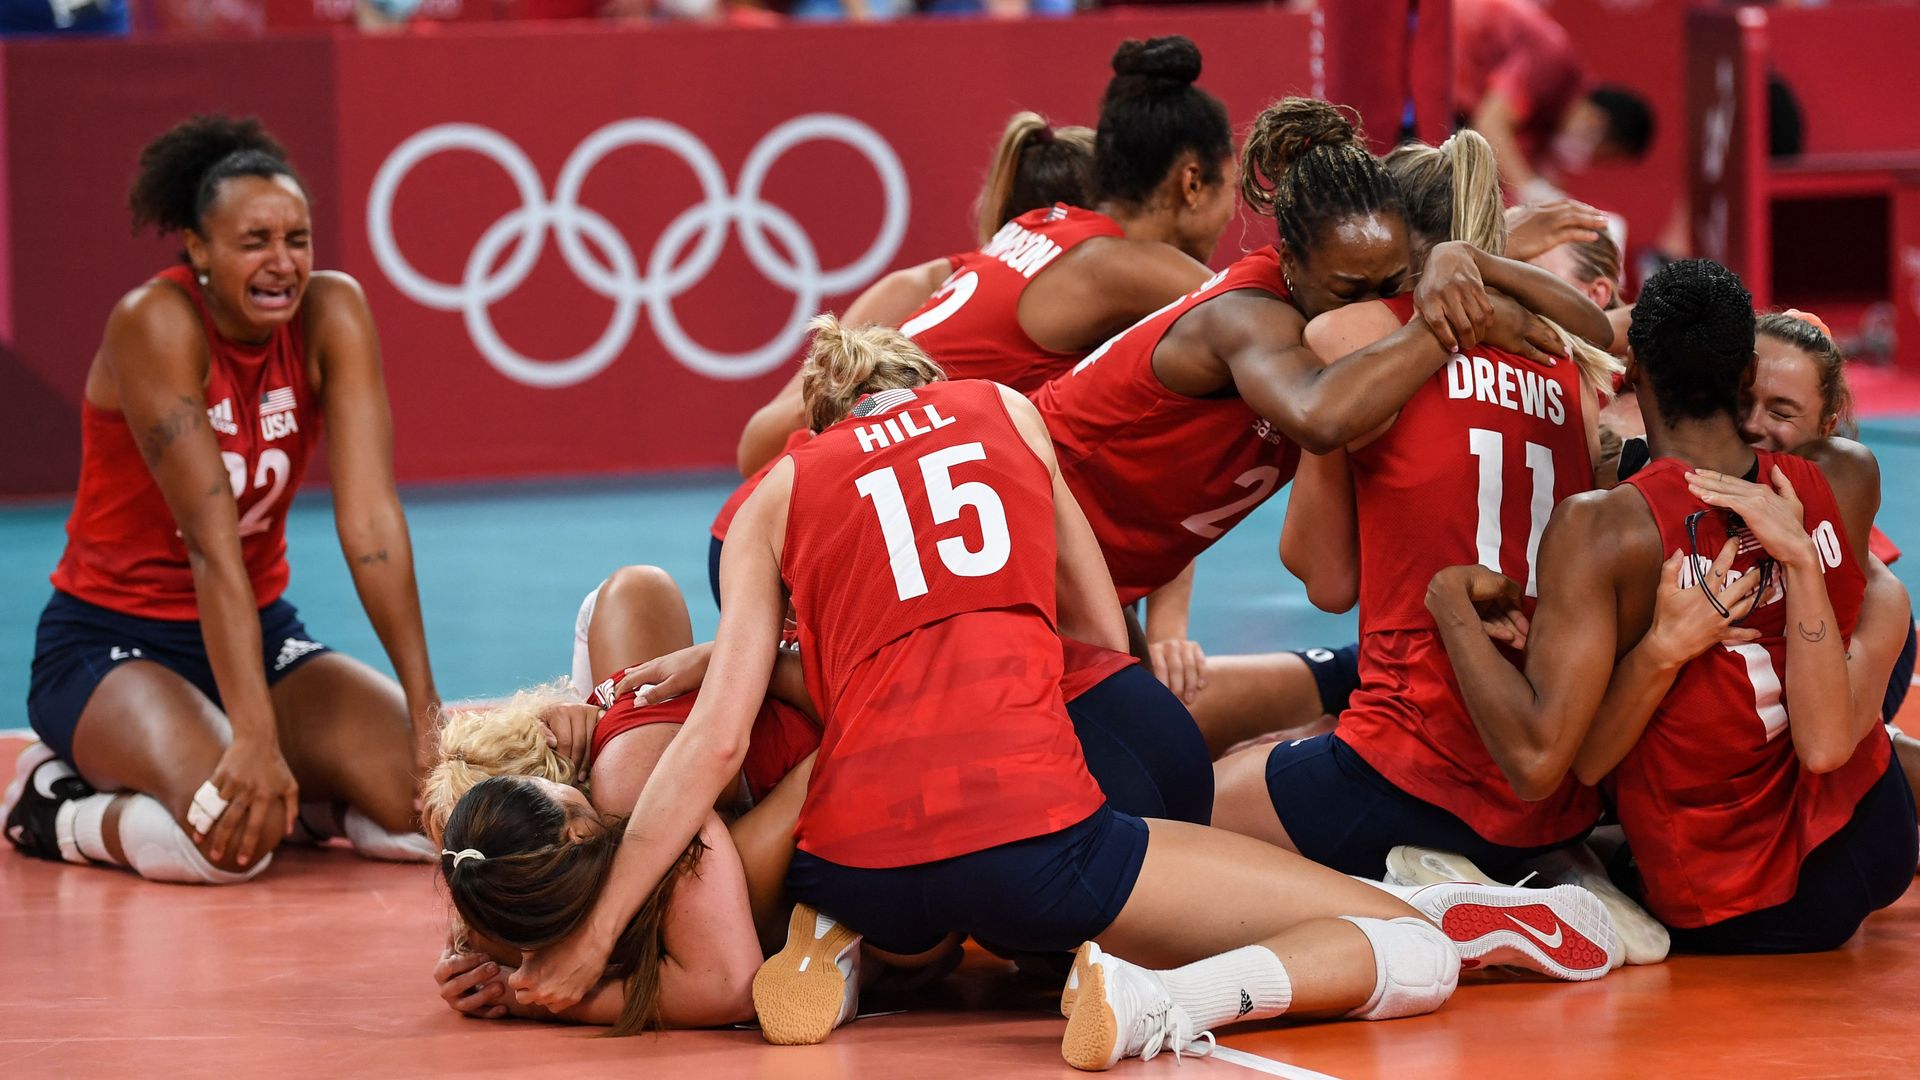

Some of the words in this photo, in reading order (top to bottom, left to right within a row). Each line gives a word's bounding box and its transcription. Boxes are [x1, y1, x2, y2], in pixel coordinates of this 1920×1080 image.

[897, 264, 979, 338] 2
[260, 410, 299, 442] USA
[1447, 353, 1566, 426] DREWS
[853, 404, 957, 453] HILL
[854, 441, 1012, 602] 15
[1469, 427, 1555, 598] 11
[1722, 640, 1789, 743] 1
